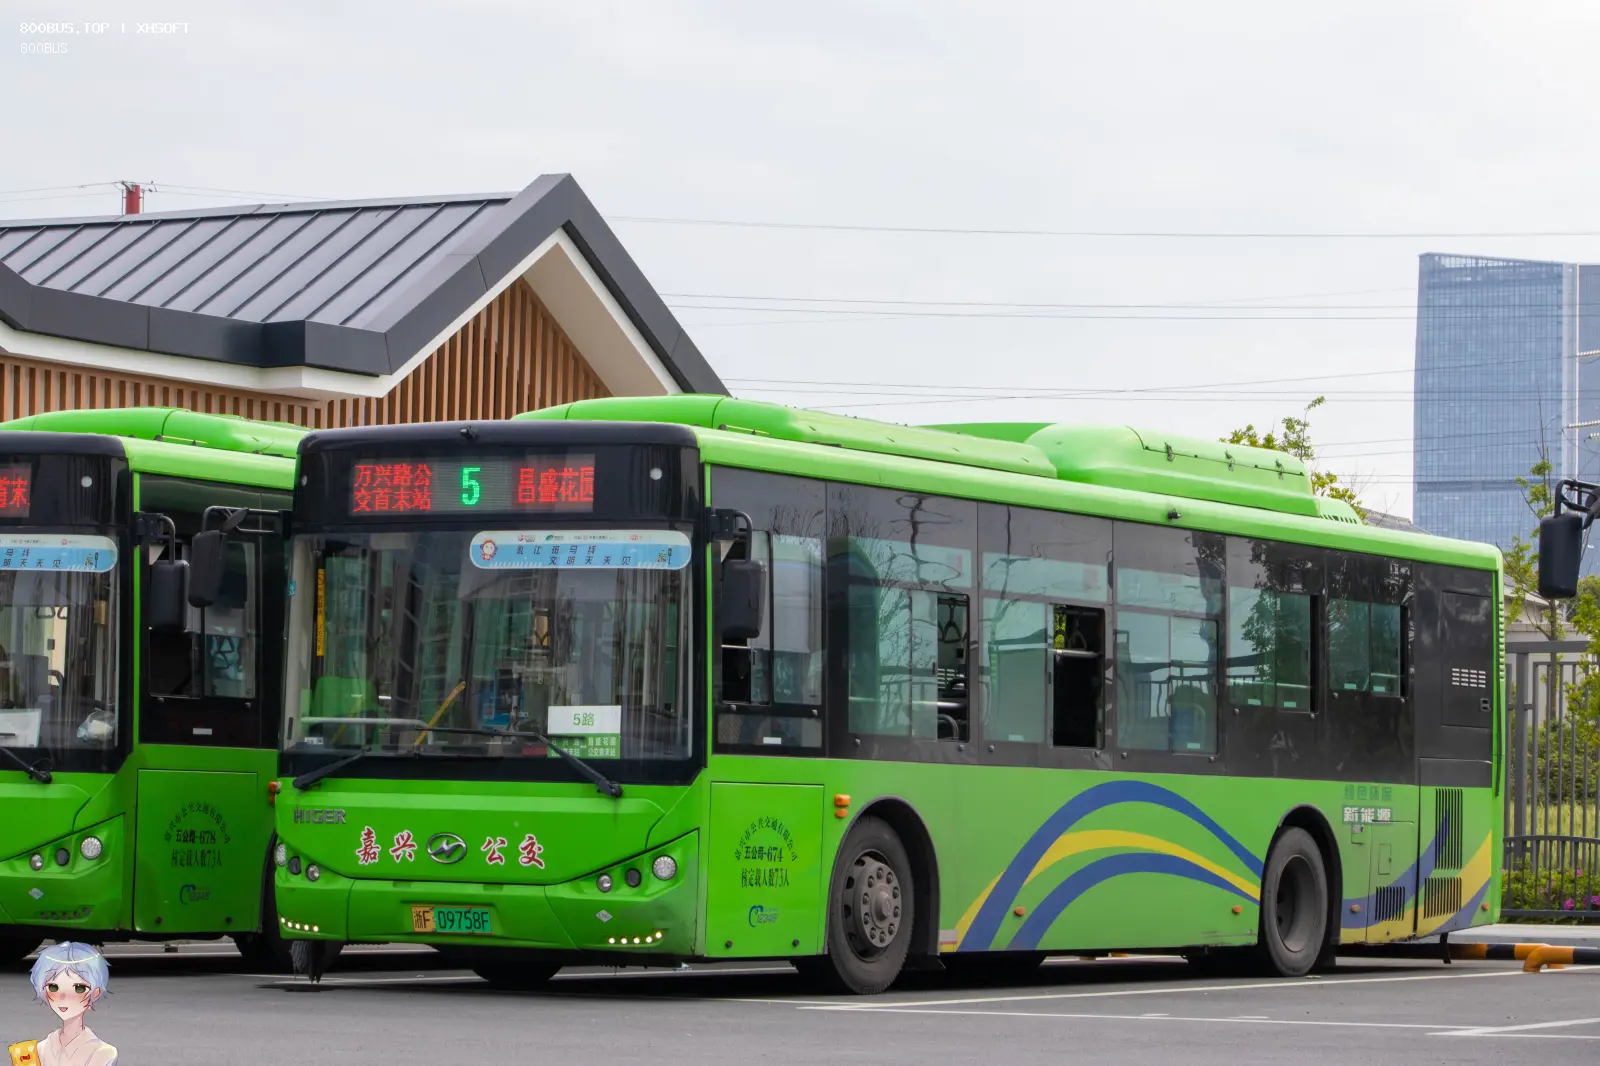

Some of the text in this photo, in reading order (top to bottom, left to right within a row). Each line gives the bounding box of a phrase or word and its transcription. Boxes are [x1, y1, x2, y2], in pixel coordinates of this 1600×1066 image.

[354, 464, 433, 487] 万兴路公
[460, 467, 482, 506] 5
[353, 488, 433, 513] 交首末站
[549, 556, 632, 565] 文明天天见
[572, 712, 596, 727] 5路
[294, 807, 346, 825] HIGER
[1343, 807, 1391, 824] 新能源
[356, 826, 545, 869] 嘉兴 公交
